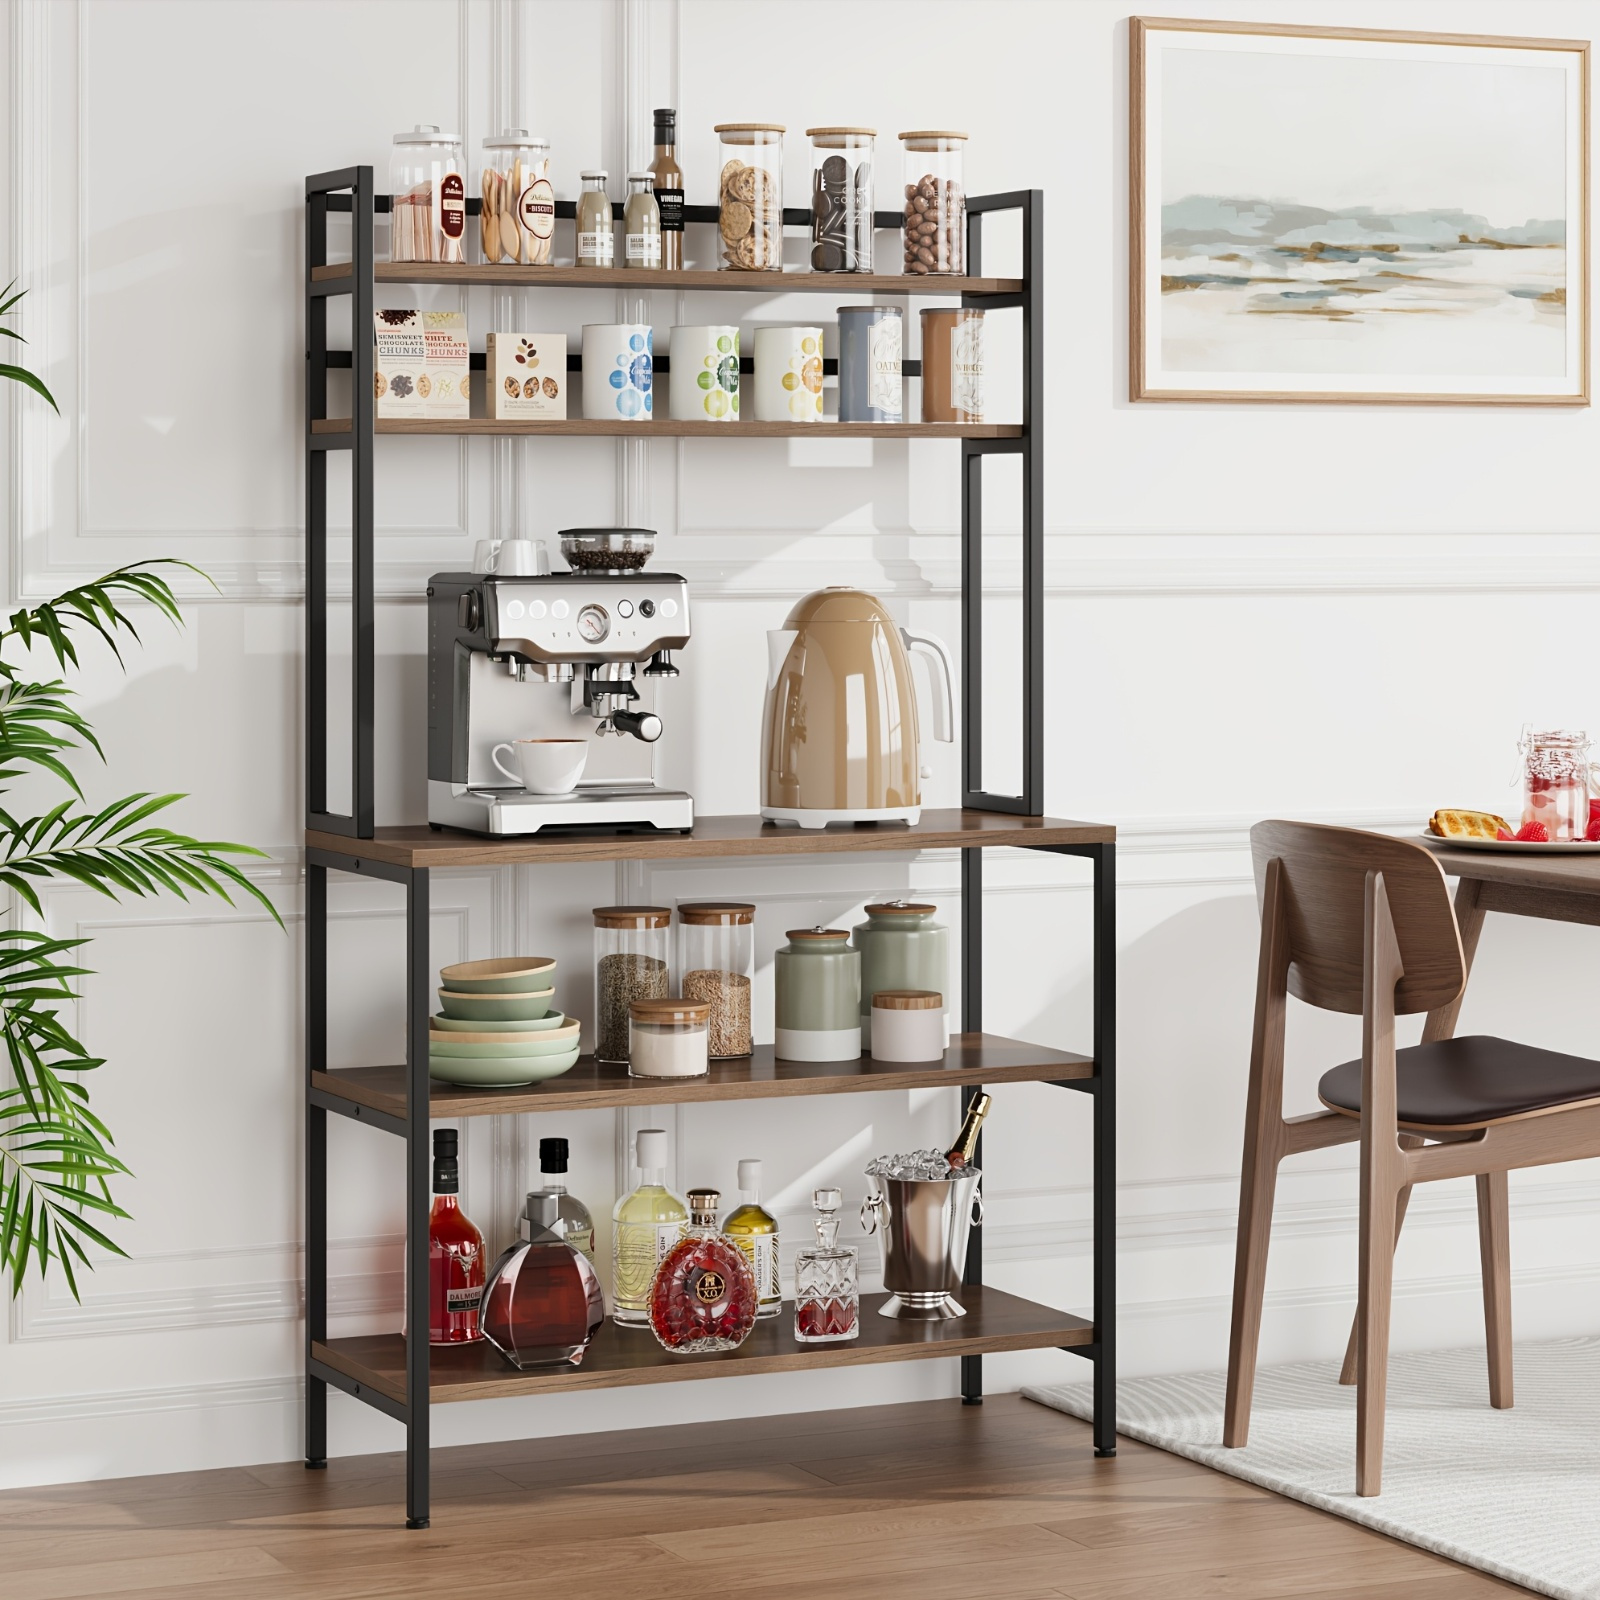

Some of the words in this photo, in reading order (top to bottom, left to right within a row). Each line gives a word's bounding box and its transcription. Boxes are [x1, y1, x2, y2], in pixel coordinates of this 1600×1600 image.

[660, 194, 683, 203] VINEGAR
[379, 346, 425, 355] CHUNKS
[450, 1291, 482, 1300] DALMORE
